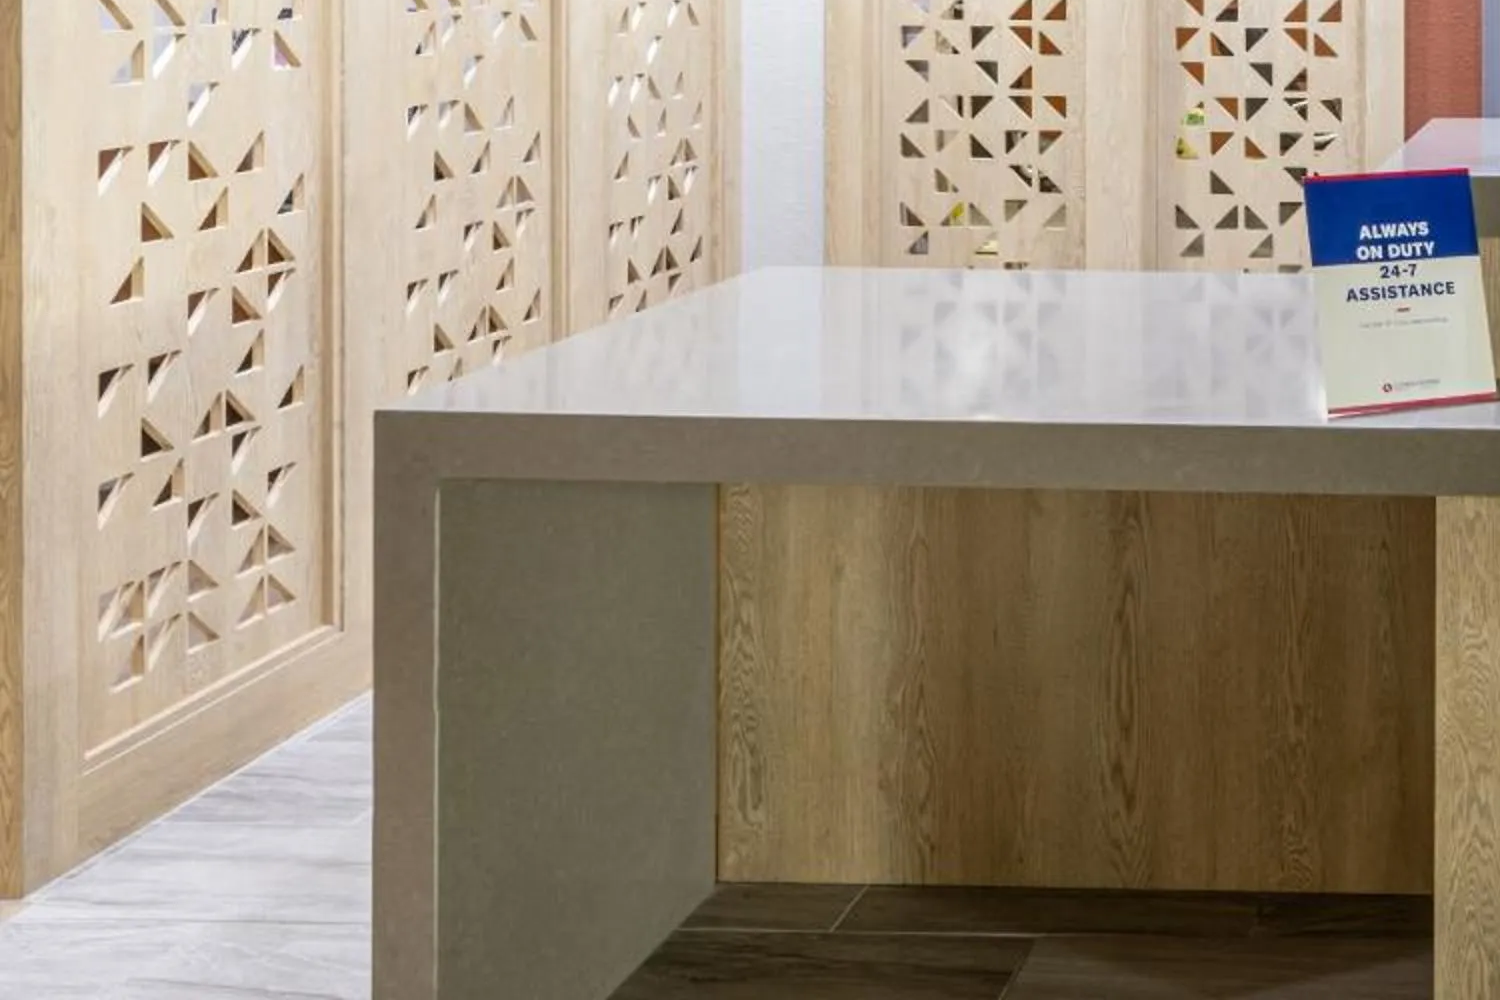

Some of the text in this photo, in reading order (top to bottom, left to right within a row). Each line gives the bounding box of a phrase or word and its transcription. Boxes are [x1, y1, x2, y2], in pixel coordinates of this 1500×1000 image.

[1359, 221, 1430, 240] ALWAYS
[1356, 241, 1435, 261] ON DUTY
[1380, 263, 1418, 279] 24-7
[1346, 281, 1456, 302] ASSISTANCE
